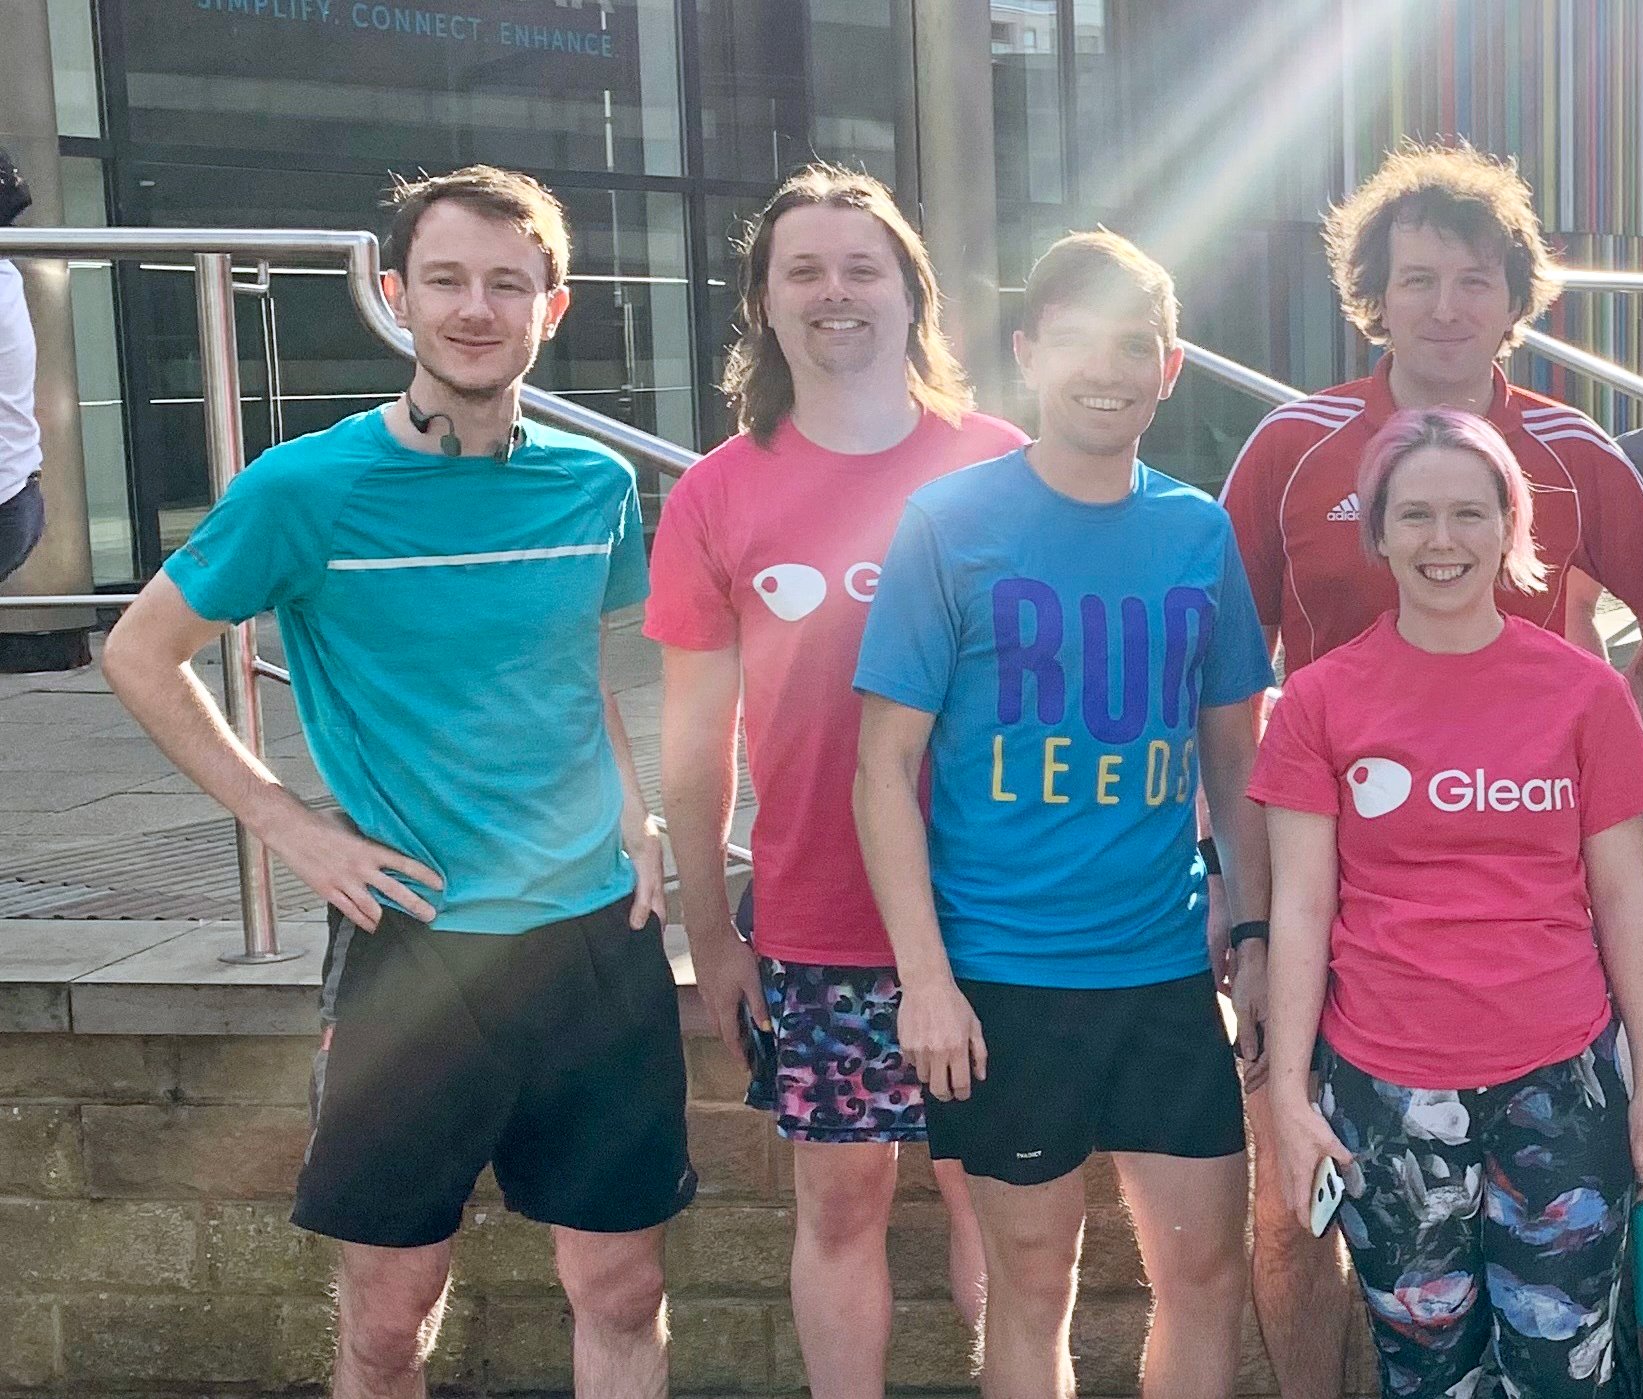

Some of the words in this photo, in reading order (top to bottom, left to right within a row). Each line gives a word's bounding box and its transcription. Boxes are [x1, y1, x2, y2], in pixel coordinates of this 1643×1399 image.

[992, 577, 1217, 745] RUN
[991, 734, 1195, 806] LEEDS
[1428, 768, 1575, 812] Glean
